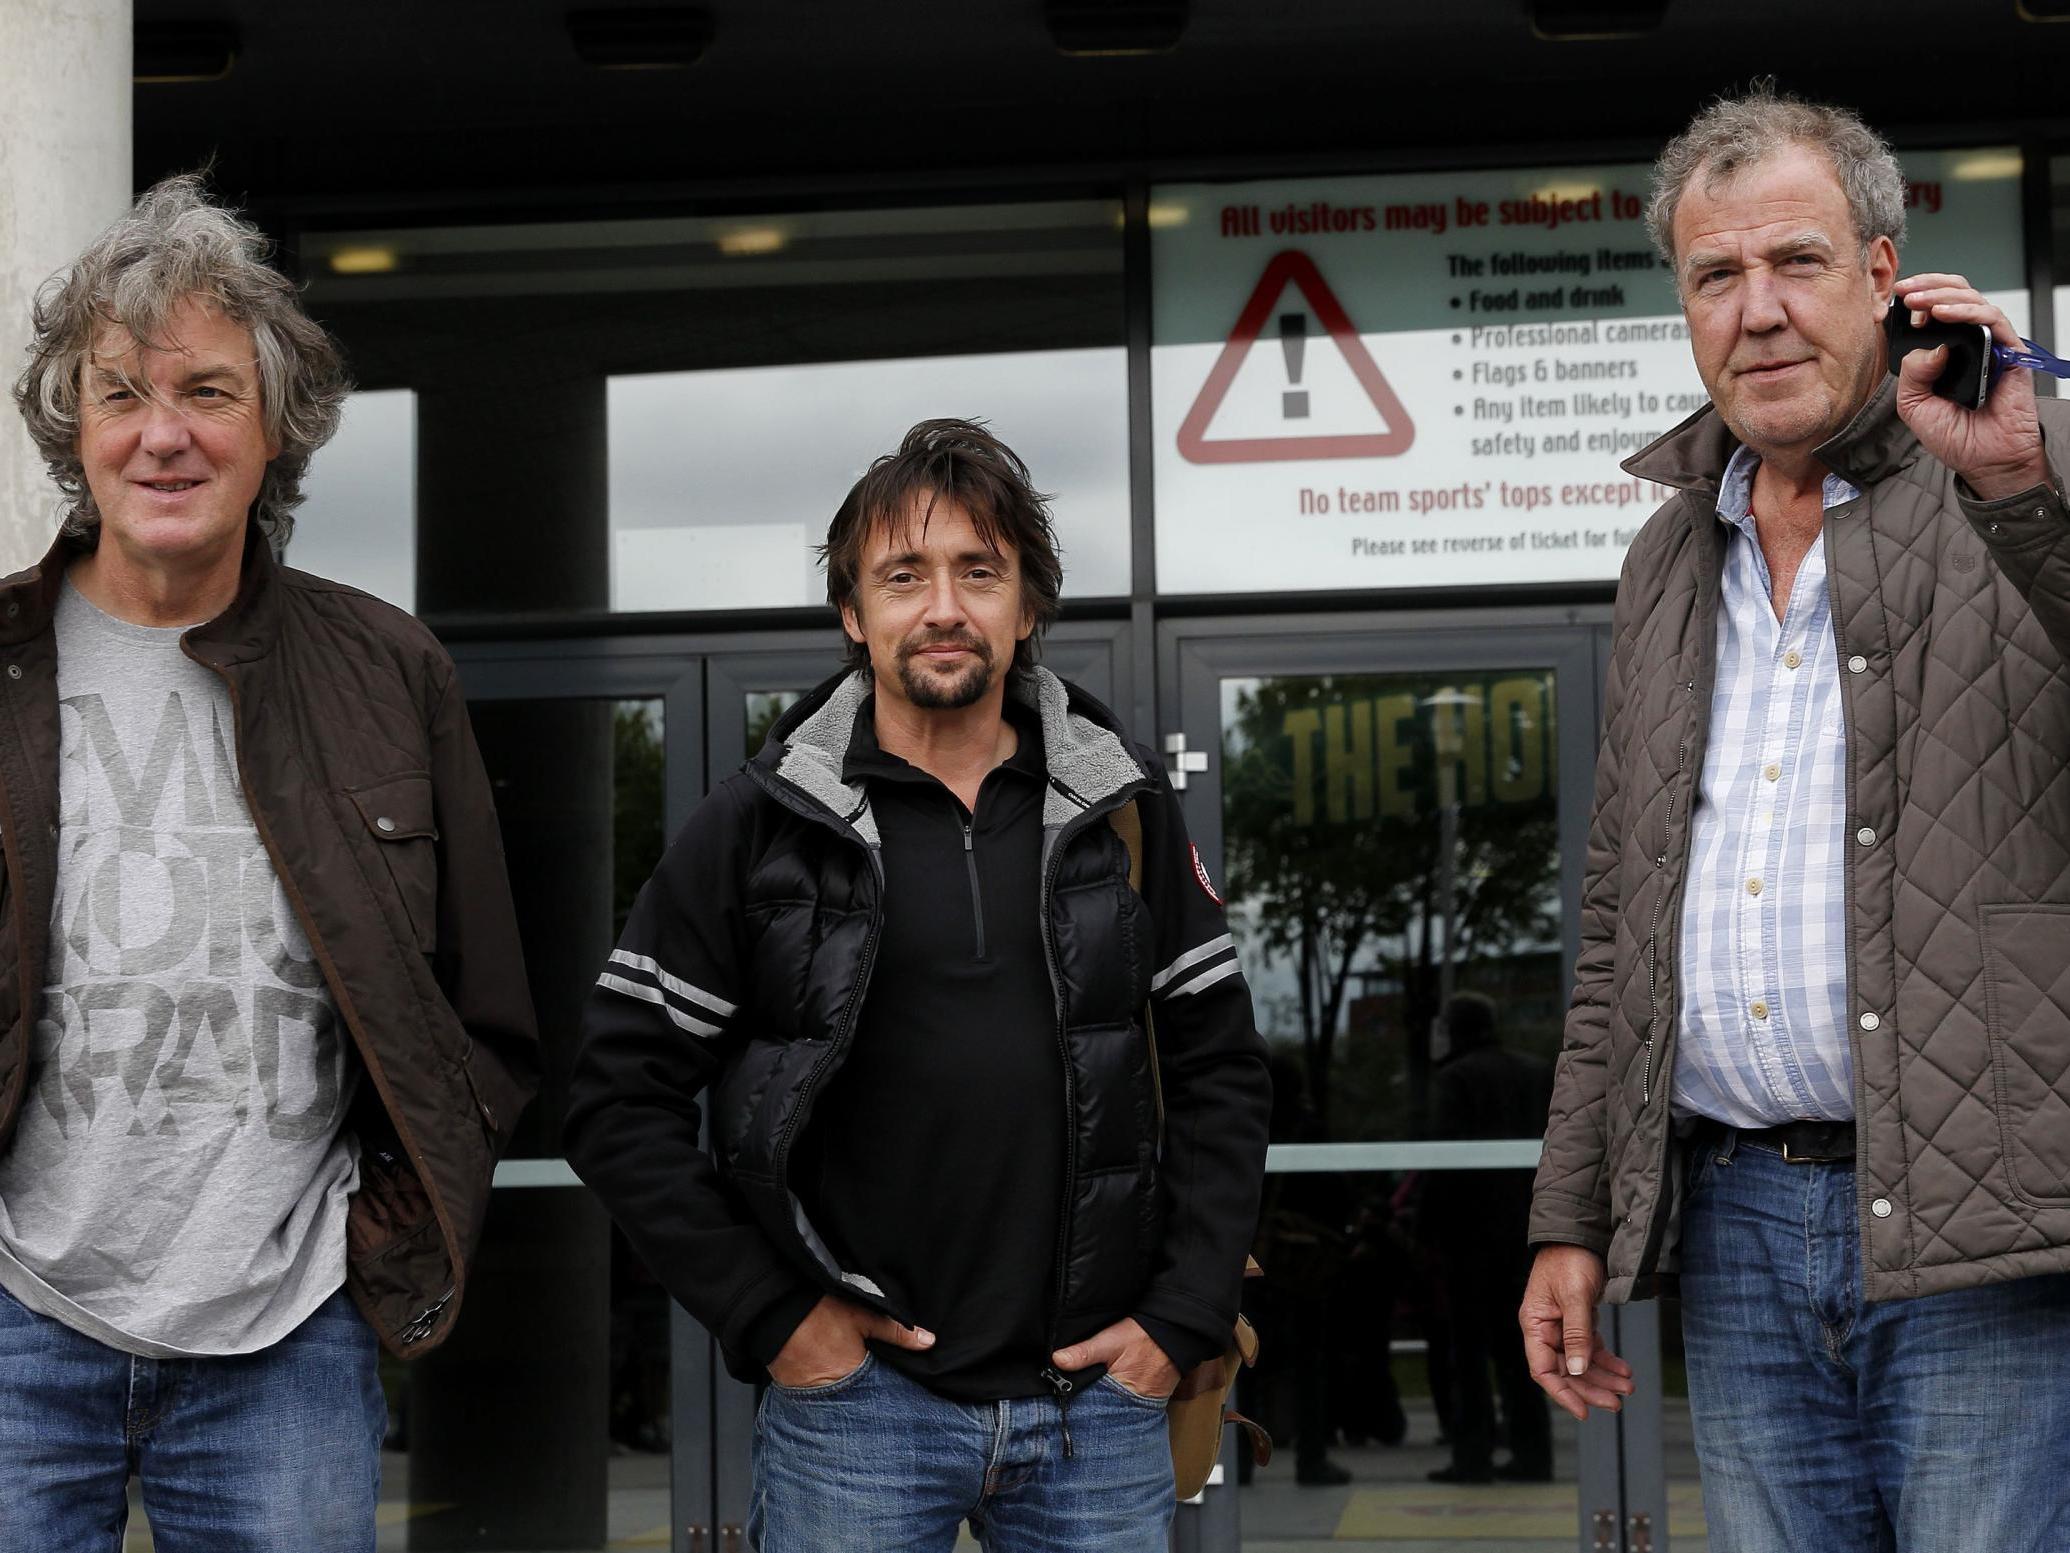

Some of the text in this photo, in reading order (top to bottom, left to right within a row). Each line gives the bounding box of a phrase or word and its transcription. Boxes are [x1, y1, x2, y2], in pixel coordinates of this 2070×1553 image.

[1221, 205, 1261, 237] All
[1269, 202, 1376, 235] visitors
[1384, 203, 1446, 235] may
[1456, 196, 1489, 228] be
[1498, 191, 1602, 230] subject
[1612, 188, 1641, 221] to
[1447, 254, 1484, 277] The
[1491, 251, 1591, 277] following
[1597, 249, 1655, 271] items
[1469, 285, 1625, 313] Food and drink
[1471, 320, 1598, 348] Professional
[1472, 359, 1638, 387] Flags & banners
[1473, 397, 1513, 423] Any
[1521, 395, 1567, 417] item
[1573, 392, 1631, 418] likely
[1639, 392, 1657, 413] to
[1471, 431, 1534, 457] safety
[1543, 431, 1580, 452] and
[1300, 488, 1330, 515] No
[1338, 486, 1400, 514] team
[1500, 481, 1552, 512] tops
[1561, 479, 1642, 508] except
[1352, 537, 1404, 556] Please
[1411, 540, 1438, 554] see
[1442, 534, 1504, 553] reverse
[1509, 532, 1525, 549] of
[1531, 530, 1578, 548] ticket
[1584, 530, 1606, 547] for
[1281, 693, 1418, 827] THE
